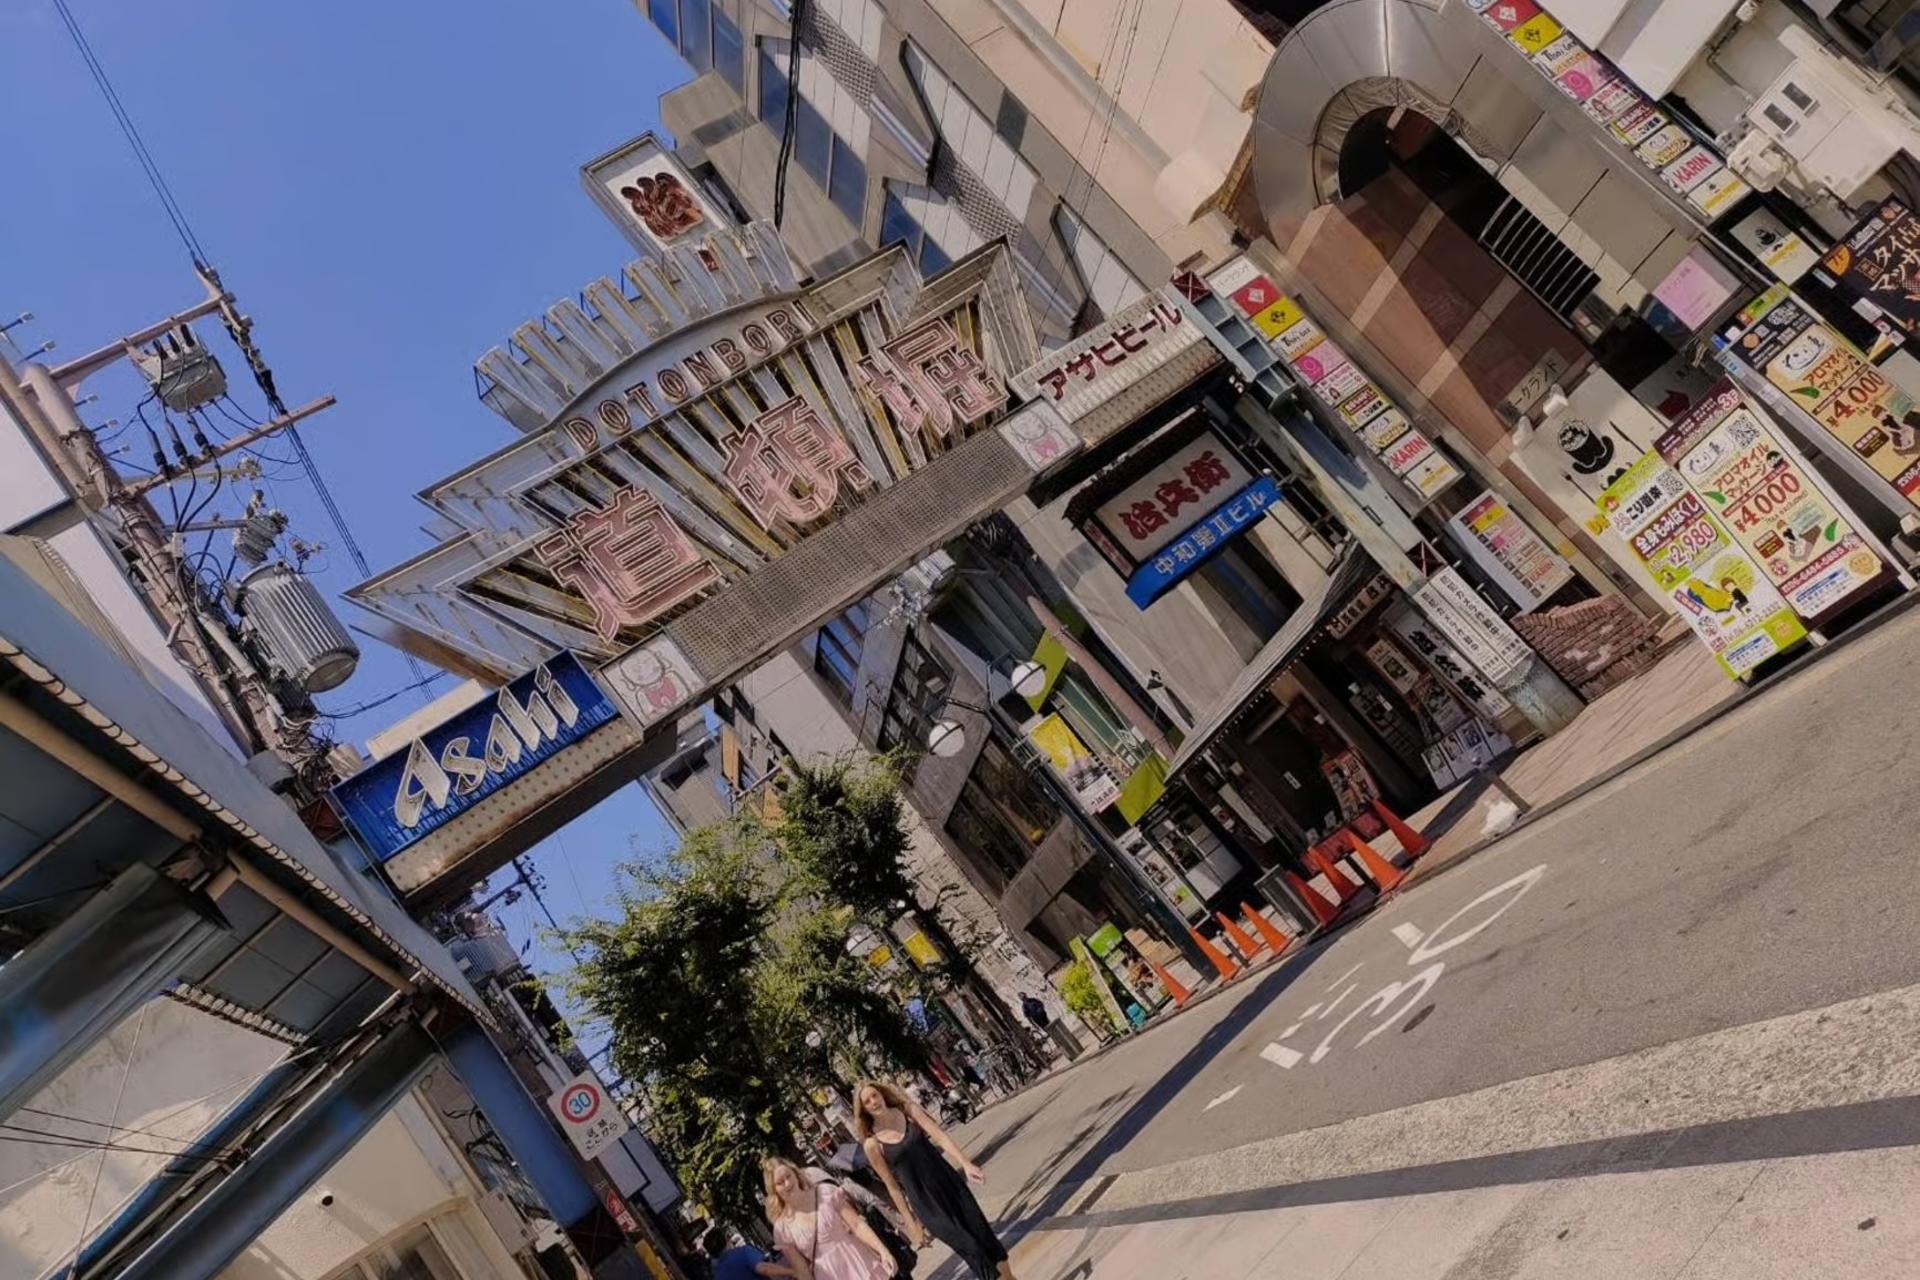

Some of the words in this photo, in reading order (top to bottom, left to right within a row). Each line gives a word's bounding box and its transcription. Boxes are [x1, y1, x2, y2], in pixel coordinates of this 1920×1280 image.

[1672, 152, 1711, 184] KARIN
[1036, 302, 1182, 400] アサヒビール
[562, 300, 816, 454] DOTONBORI
[1715, 389, 1740, 411] 3F
[1390, 435, 1428, 467] KARIN
[1713, 441, 1770, 490] アロマオイル
[534, 316, 1010, 645] 道頓堀
[1118, 449, 1231, 541] 治兵衛
[1724, 461, 1769, 499] マッサージ
[1625, 484, 1663, 520] こり道楽
[394, 663, 579, 828] Asahi
[569, 1091, 592, 1115] 30
